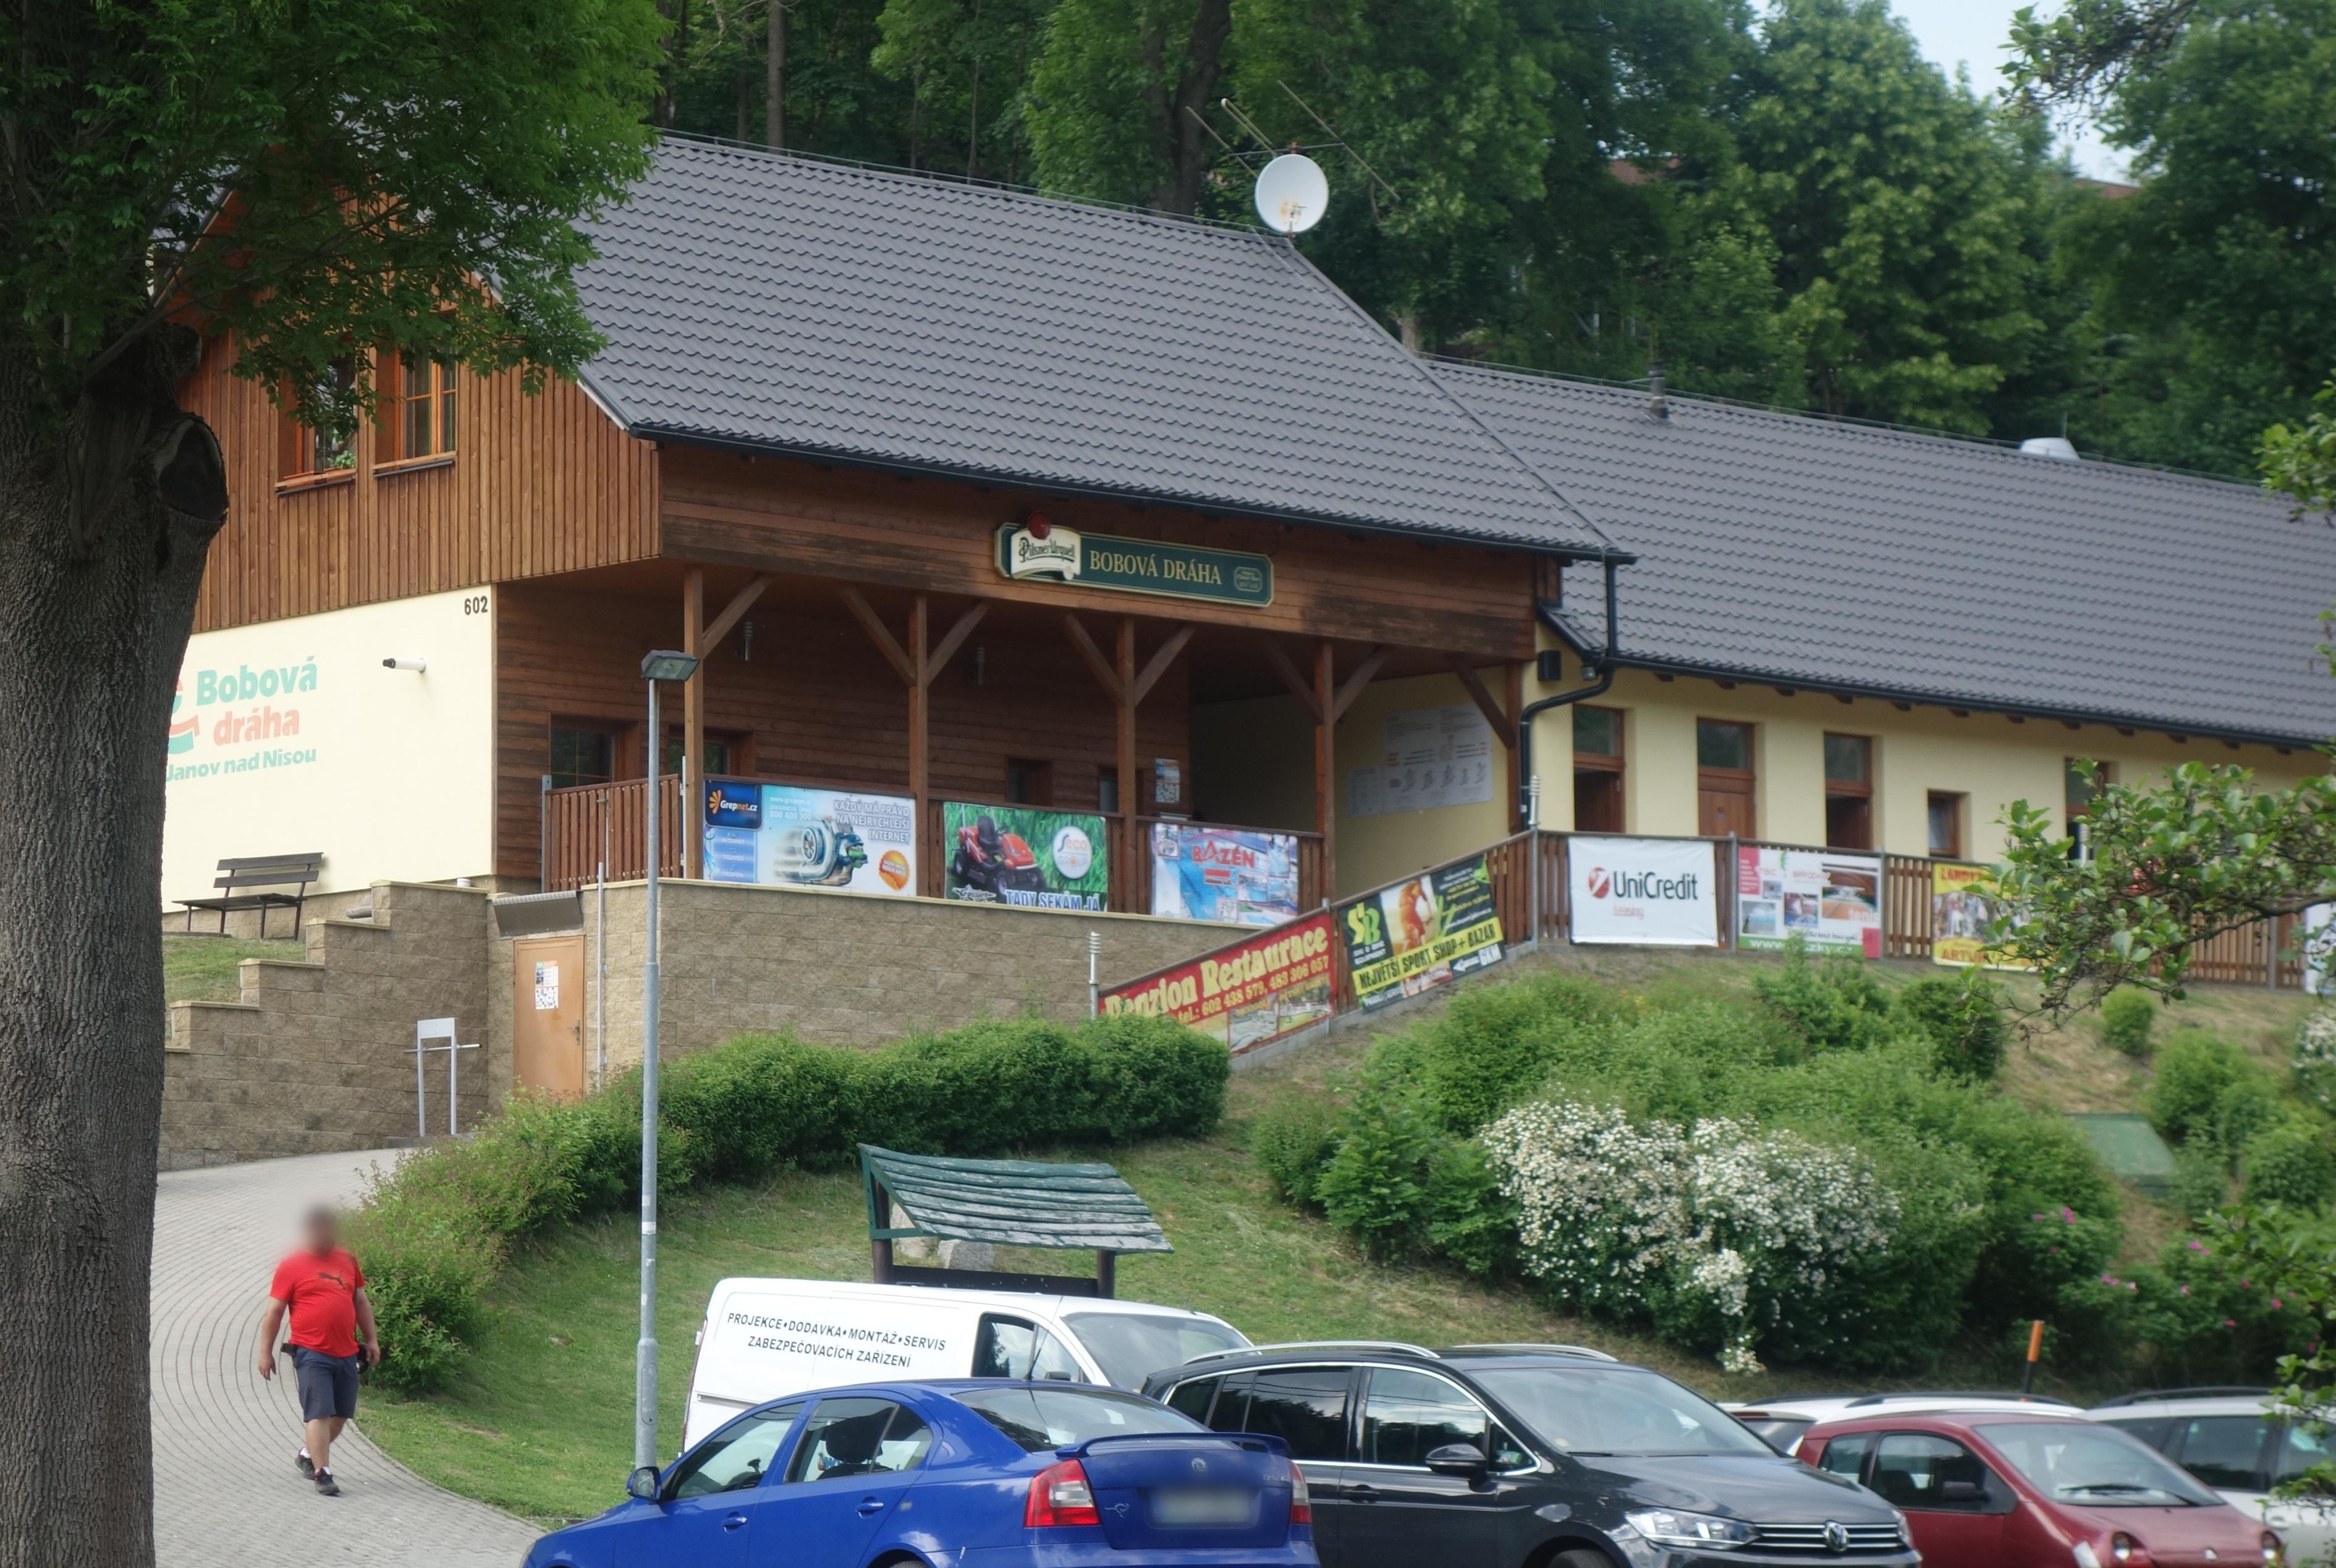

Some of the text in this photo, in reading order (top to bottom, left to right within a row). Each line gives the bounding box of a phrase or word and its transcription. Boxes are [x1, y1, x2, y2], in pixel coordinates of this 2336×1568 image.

[1018, 536, 1075, 563] Pilsner Urquell
[1090, 550, 1157, 578] BOBOVÁ
[1163, 559, 1222, 585] DRÁHA
[464, 596, 488, 616] 602
[196, 656, 318, 706] Bobová
[213, 705, 300, 746] dráha
[166, 748, 317, 782] Janov nad Nisou
[720, 800, 758, 812] Grepnet.cz
[834, 798, 910, 816] KAŽDÝ MÁ PRÁVO
[837, 813, 910, 829] NA NEJRYCHLEJŠÍ
[868, 829, 910, 842] INTERNET
[1191, 841, 1256, 868] BAZÉN
[1613, 870, 1699, 901] UniCredit
[1005, 889, 1100, 912] TADY SEKÁM JÁ
[1613, 905, 1644, 920] Leasing
[1199, 926, 1329, 999] Restaurace
[1359, 958, 1400, 989] NEJVĚTŠÍ
[1402, 948, 1432, 973] SPORT
[1432, 938, 1457, 961] SHOP
[1468, 923, 1496, 947] BAZAR
[727, 1312, 946, 1351] PROJEKCE DODÁVKA MONTÁŽ SERVIS
[748, 1335, 912, 1368] ZABEZPEČOVACÍCH ZAŘÍZENÍ
